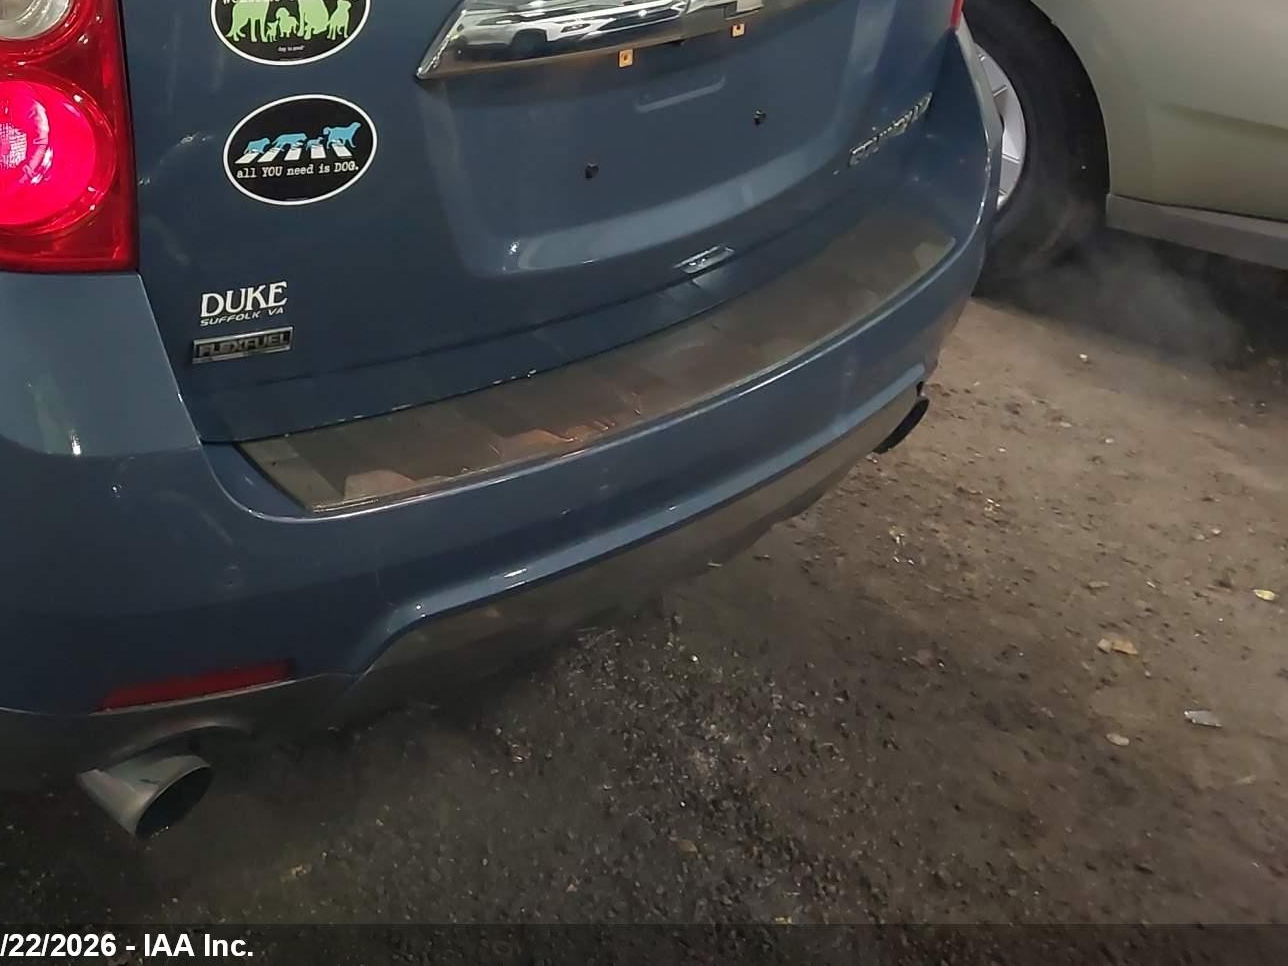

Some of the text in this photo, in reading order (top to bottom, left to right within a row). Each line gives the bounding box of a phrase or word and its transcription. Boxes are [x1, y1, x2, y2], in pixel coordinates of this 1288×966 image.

[236, 160, 359, 179] all YOU need is DOG.
[200, 281, 288, 318] DUKE
[200, 306, 284, 327] SUFFOLK VA
